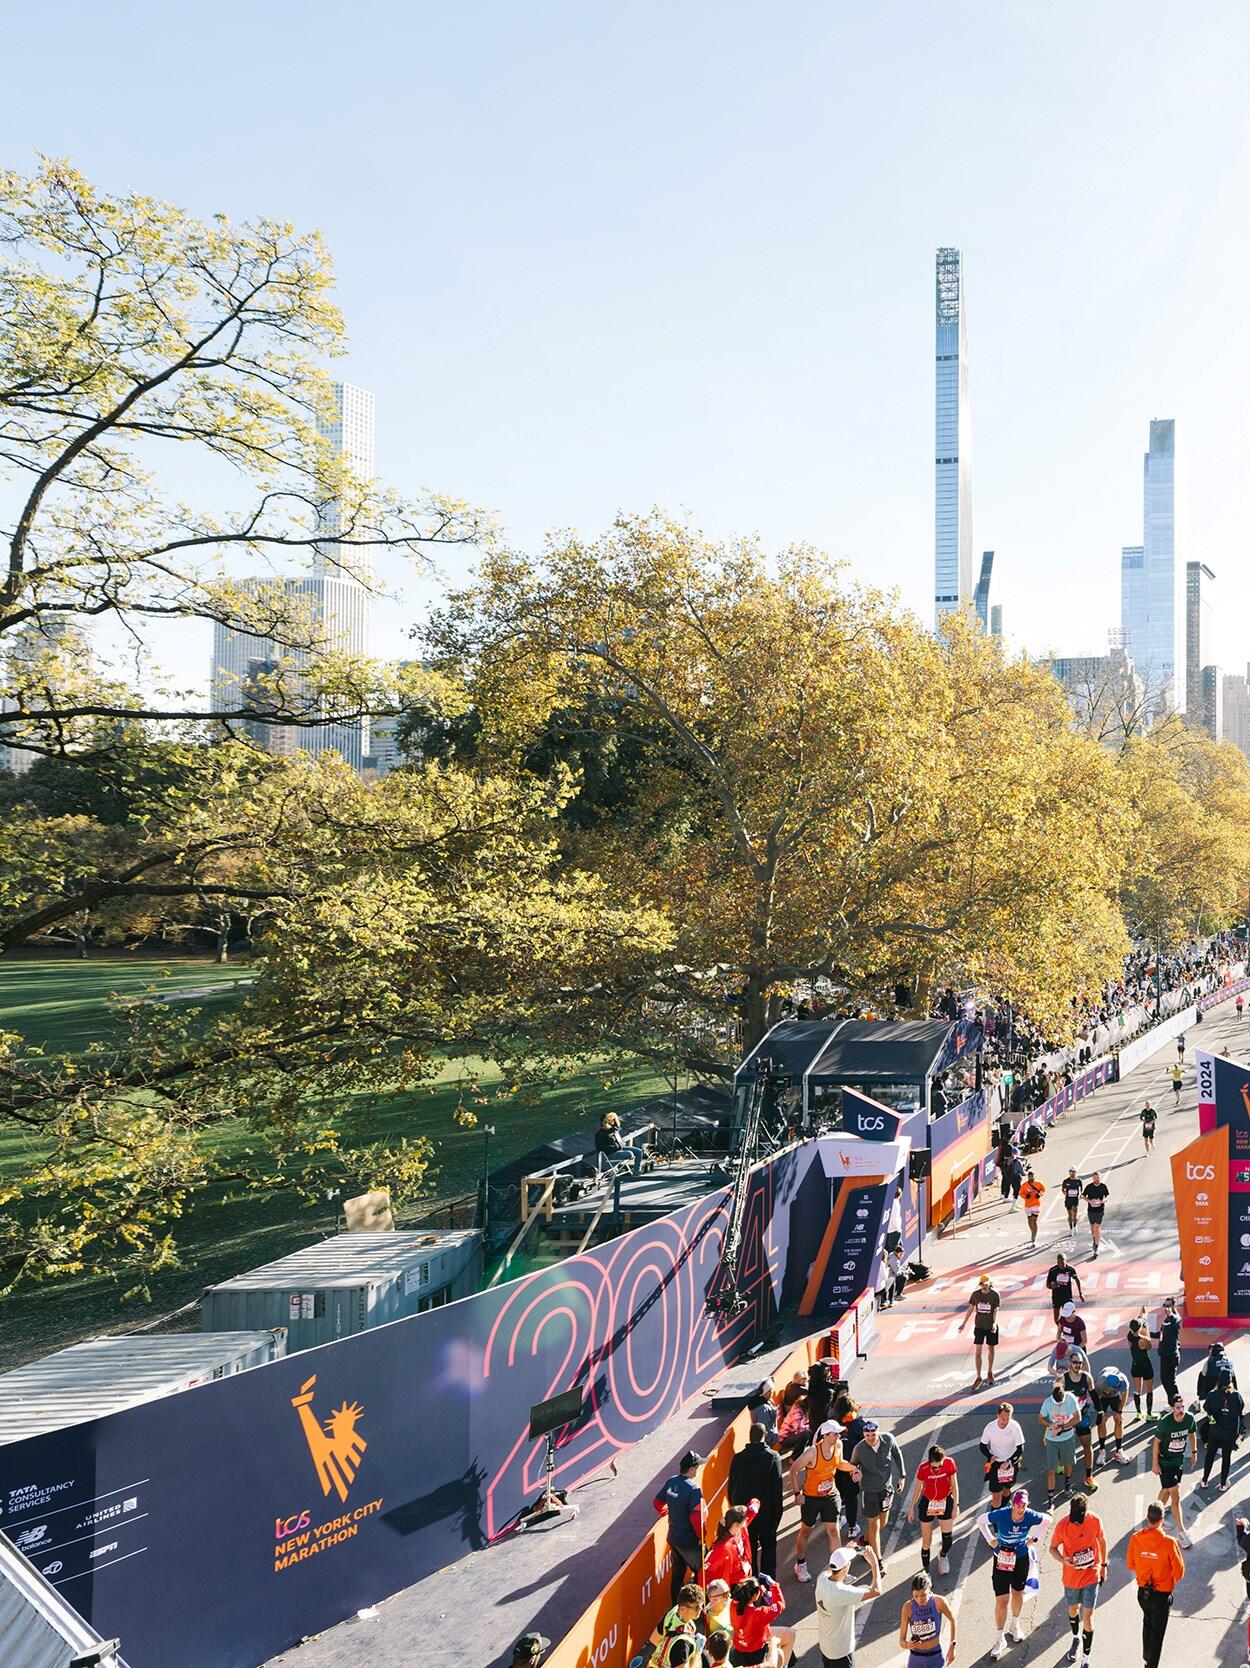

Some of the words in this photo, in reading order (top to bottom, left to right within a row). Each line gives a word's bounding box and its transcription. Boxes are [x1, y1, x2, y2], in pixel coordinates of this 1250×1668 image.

[1200, 1061, 1213, 1099] 2024
[857, 1114, 885, 1131] tcs
[1235, 1130, 1248, 1138] tcs
[1186, 1161, 1215, 1181] tcs
[483, 1162, 780, 1541] 2024
[8, 1480, 75, 1506] CONSULTANCY
[9, 1484, 38, 1498] TATA
[8, 1495, 52, 1514] SERVICES
[85, 1504, 122, 1521] UNITED
[75, 1510, 122, 1529] AIRLINES
[275, 1509, 311, 1539] tcs
[275, 1531, 312, 1557] NEW
[313, 1513, 352, 1539] YORK
[353, 1498, 384, 1521] CITY
[21, 1538, 53, 1552] balance
[89, 1541, 119, 1559] ESPN
[274, 1524, 358, 1573] MARATHON
[641, 1575, 653, 1606] IT
[590, 1623, 618, 1668] YOU
